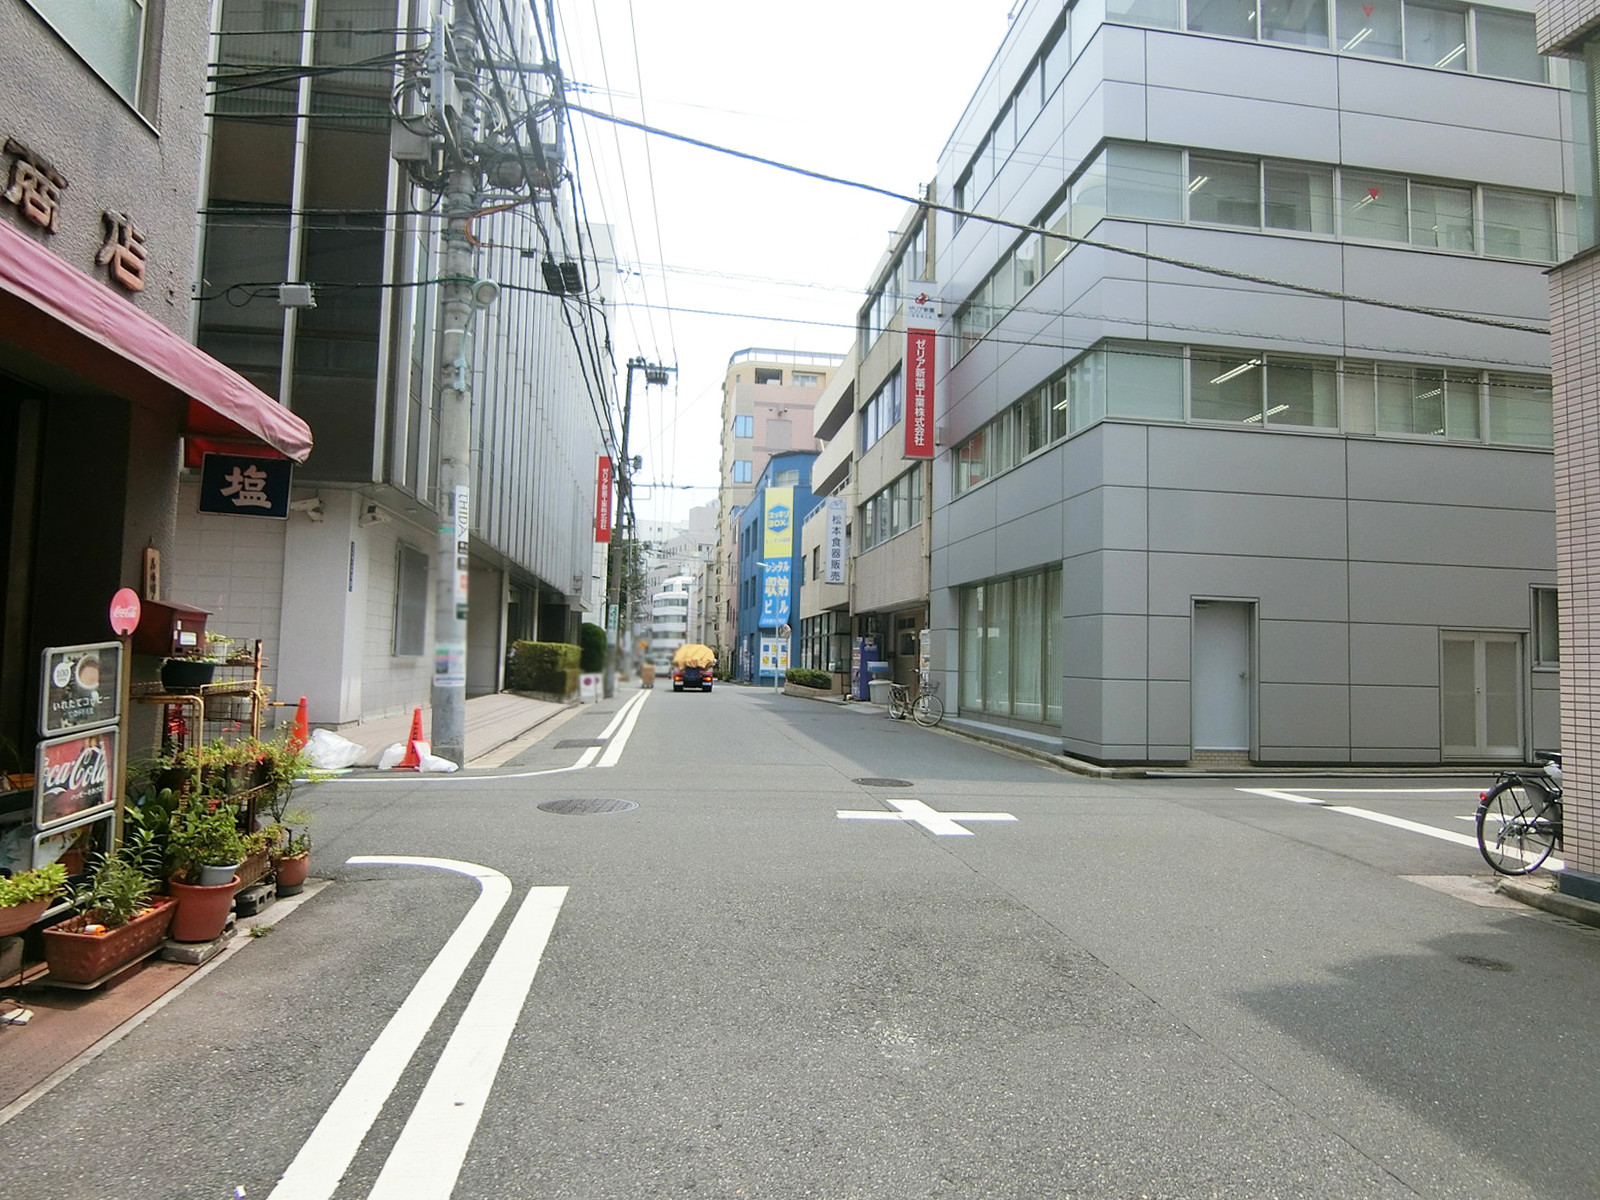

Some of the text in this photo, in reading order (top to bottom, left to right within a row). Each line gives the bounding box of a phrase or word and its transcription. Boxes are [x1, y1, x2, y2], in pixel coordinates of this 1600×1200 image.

[2, 137, 148, 292] 商店
[913, 339, 927, 446] ゼリア新薬工業株式会社
[220, 464, 272, 509] 塩
[830, 515, 842, 582] 松本食器販売
[764, 560, 790, 573] レンタル
[764, 575, 789, 597] 収納
[764, 599, 789, 614] ビル
[52, 695, 111, 711] いれたてコヒー
